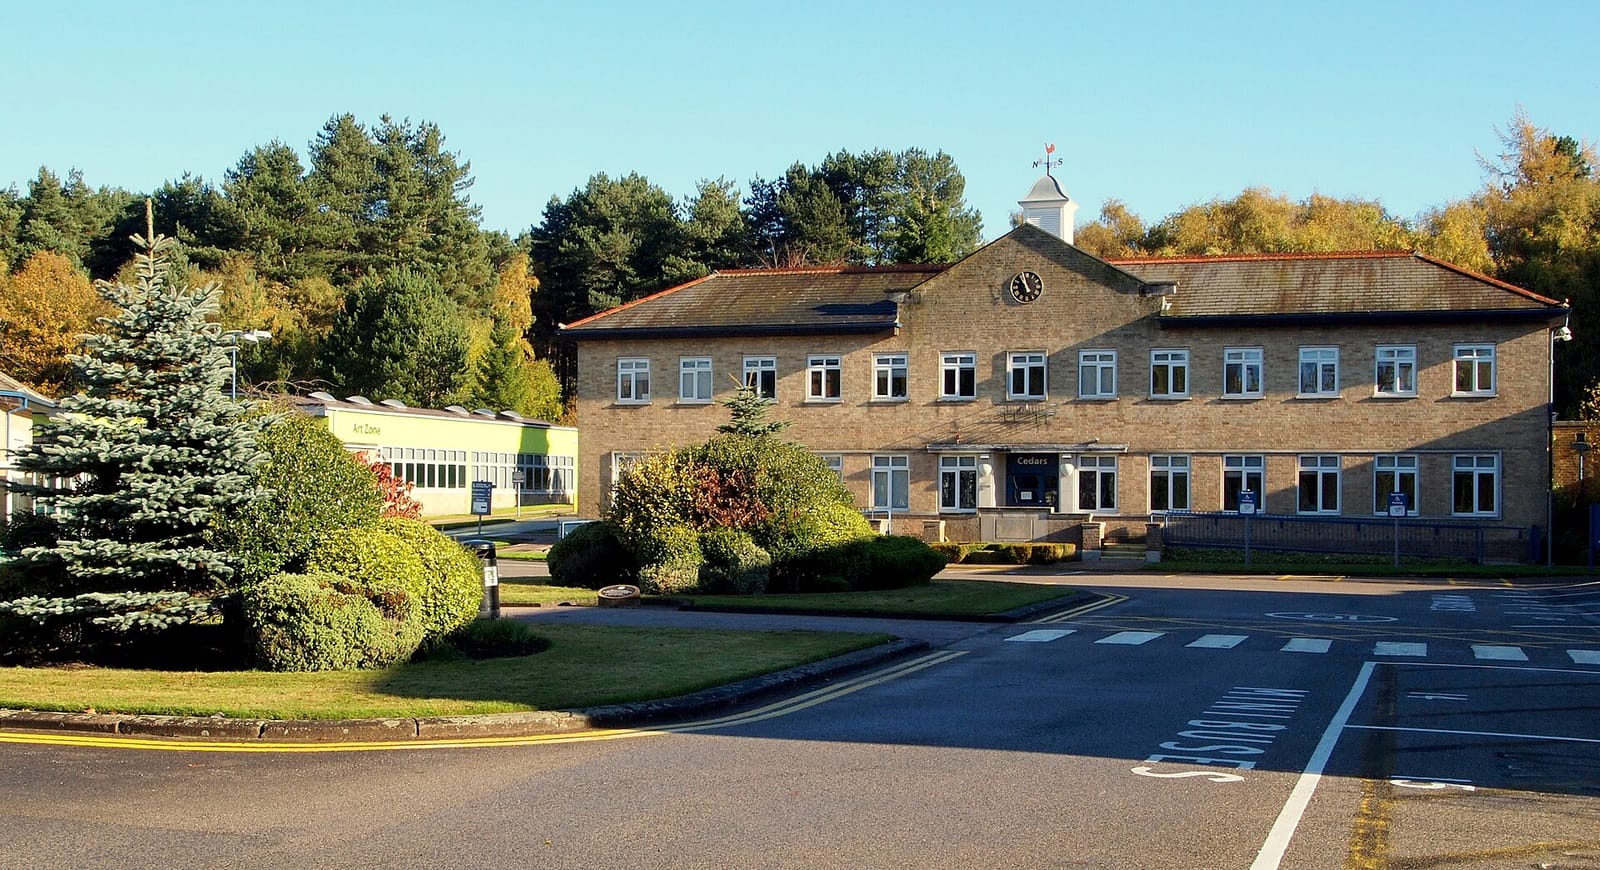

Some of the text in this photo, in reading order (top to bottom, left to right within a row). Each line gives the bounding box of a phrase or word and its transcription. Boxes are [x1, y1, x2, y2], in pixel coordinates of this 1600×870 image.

[353, 423, 381, 435] Art Zone
[1017, 456, 1048, 465] Cedars
[1130, 686, 1310, 783] MINIBUSES
